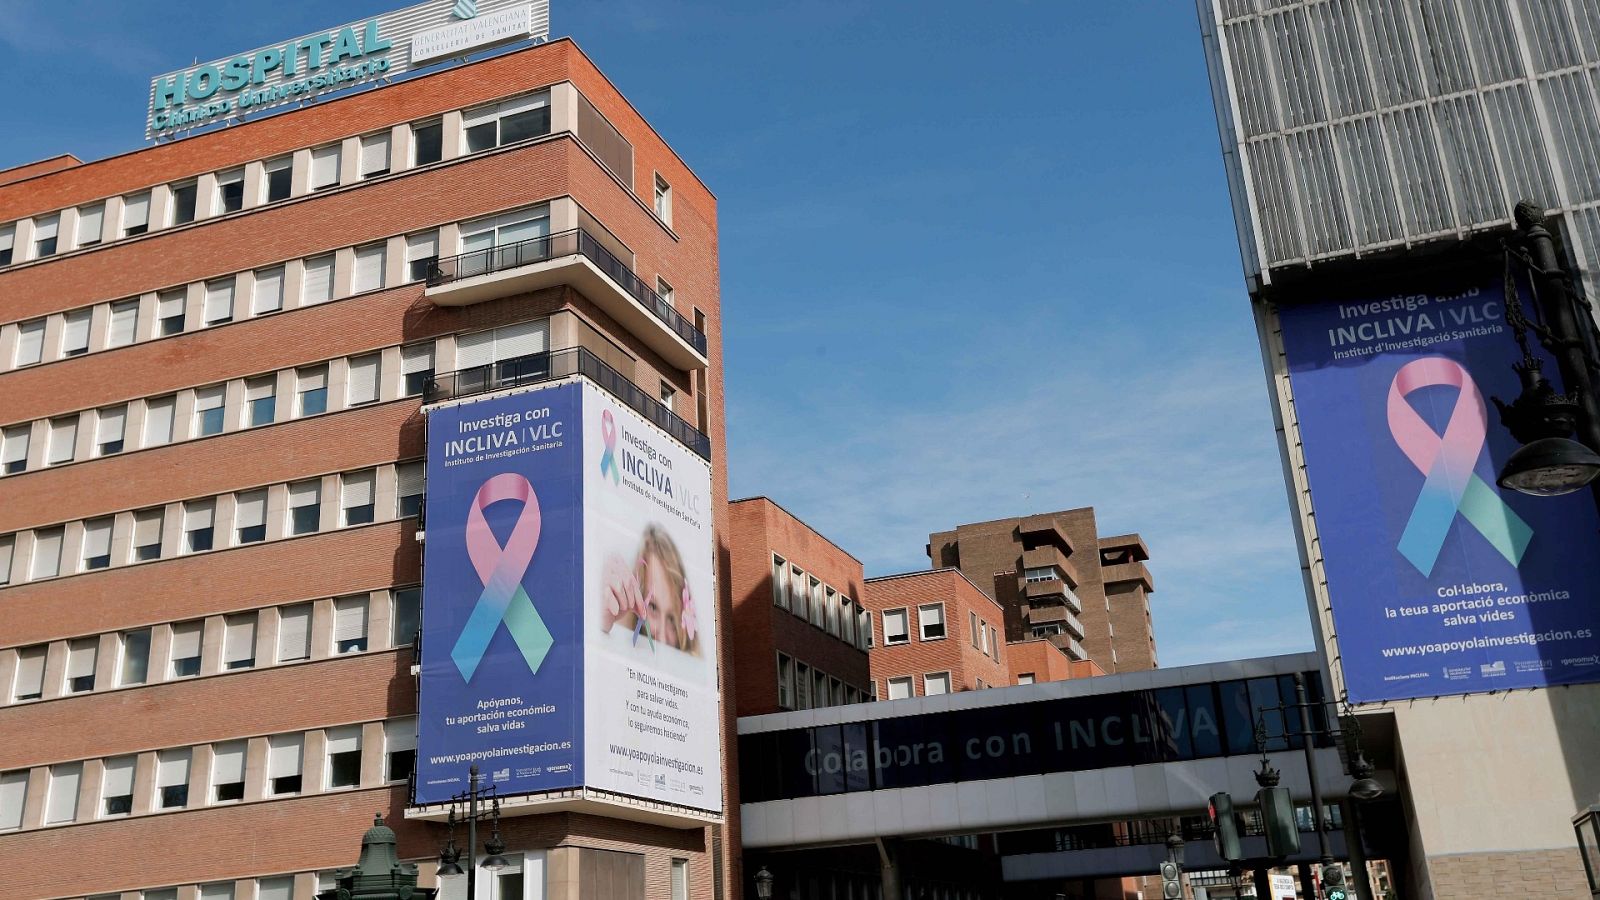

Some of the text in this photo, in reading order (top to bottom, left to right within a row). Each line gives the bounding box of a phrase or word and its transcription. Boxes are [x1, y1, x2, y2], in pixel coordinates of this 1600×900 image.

[414, 22, 527, 57] CONSELLERIA DE SANITAT
[415, 10, 527, 46] GENERALITAT VALENCIANA
[153, 19, 393, 111] HOSPITAL
[239, 57, 391, 108] Universitario
[1339, 293, 1429, 320] Investiga
[1328, 301, 1500, 347] INCLIVA VLC
[1333, 324, 1503, 360] Institut d'Investigació Sanitària
[459, 407, 550, 434] Investiga con
[444, 440, 563, 467] Instituto de Investigación Sanitaria
[445, 421, 563, 458] INCLIVA VLC
[621, 425, 673, 470] Investiga con
[621, 448, 700, 514] INCLIVA VLC
[622, 475, 645, 496] Instituto
[644, 489, 652, 500] de
[1385, 589, 1570, 618] la teua aportació econòmica
[1443, 610, 1515, 627] salva vides
[1382, 627, 1592, 658] www.yoapoyolainvestigacion.es
[636, 671, 657, 685] INCLIVA
[657, 678, 689, 698] investigamos
[636, 689, 649, 700] para
[649, 693, 665, 705] salvar
[446, 703, 556, 726] tu aportación económica
[477, 696, 524, 710] Apóyanos,
[625, 699, 630, 710] Y
[630, 703, 640, 713] con
[640, 705, 647, 714] tu
[647, 707, 663, 720] ayuda
[477, 720, 525, 734] salva vidas
[628, 716, 634, 728] lo
[634, 720, 663, 736] seguiremos
[430, 740, 572, 765] www.yoapoyolainvestigacion.es
[609, 743, 704, 776] www.yoapoyolainvestigacion.es
[804, 739, 944, 776] Colabora
[966, 729, 1032, 761] con
